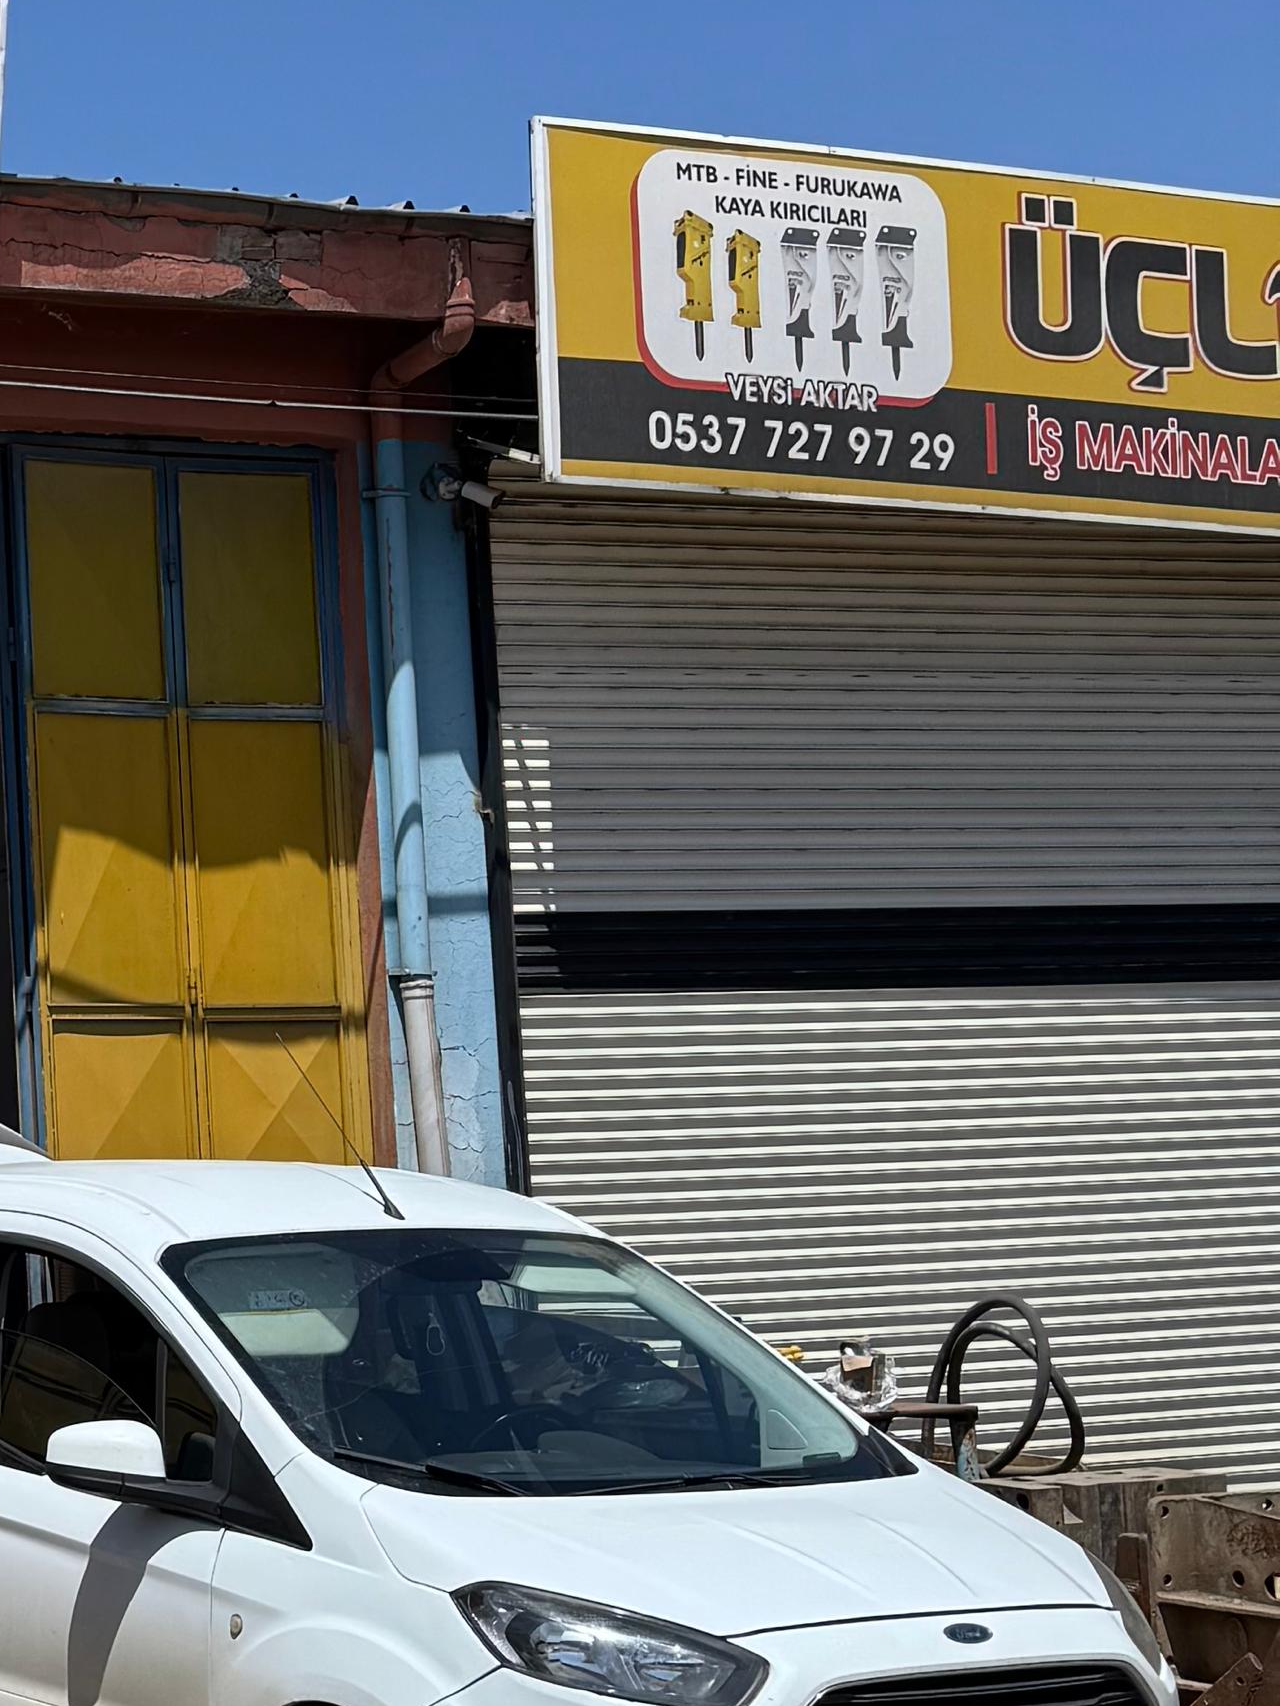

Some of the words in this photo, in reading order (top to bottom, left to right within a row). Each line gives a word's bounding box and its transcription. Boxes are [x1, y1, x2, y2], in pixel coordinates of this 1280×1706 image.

[676, 162, 718, 183] MTB
[736, 164, 778, 190] FİNE
[795, 174, 902, 203] FURUKAWA
[715, 195, 765, 217] KAYA
[770, 201, 867, 229] KIRICILARI
[800, 379, 878, 413] AKTAR
[648, 410, 747, 455] 0537
[764, 419, 833, 462] 727
[848, 426, 894, 467] 97
[908, 430, 956, 472] 29
[1027, 404, 1064, 482] İŞ
